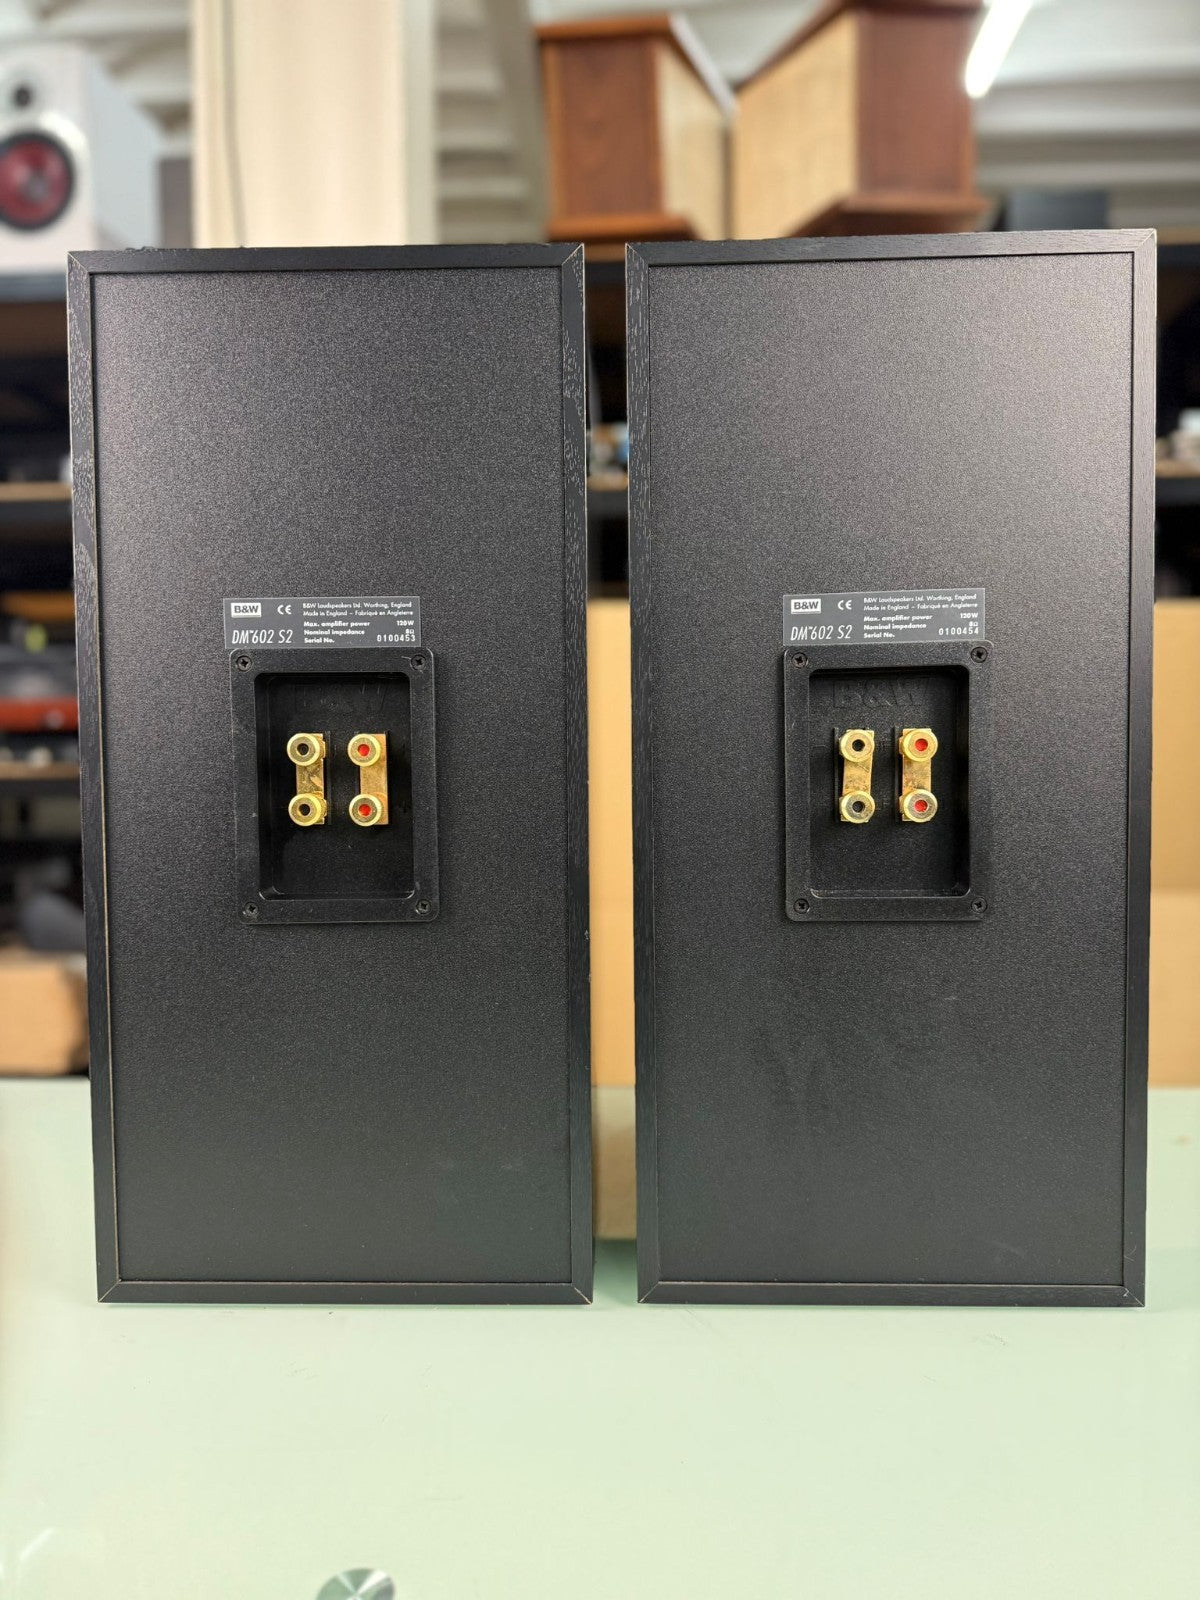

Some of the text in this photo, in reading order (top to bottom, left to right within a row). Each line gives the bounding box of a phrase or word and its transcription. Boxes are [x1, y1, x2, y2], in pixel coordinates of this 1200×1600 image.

[234, 605, 259, 613] B&W
[277, 605, 291, 614] CE
[794, 601, 819, 610] B&W
[838, 600, 852, 610] CE
[838, 625, 852, 638] S2
[939, 627, 979, 635] 0100454
[279, 630, 293, 643] S2
[377, 634, 415, 642] 0100453
